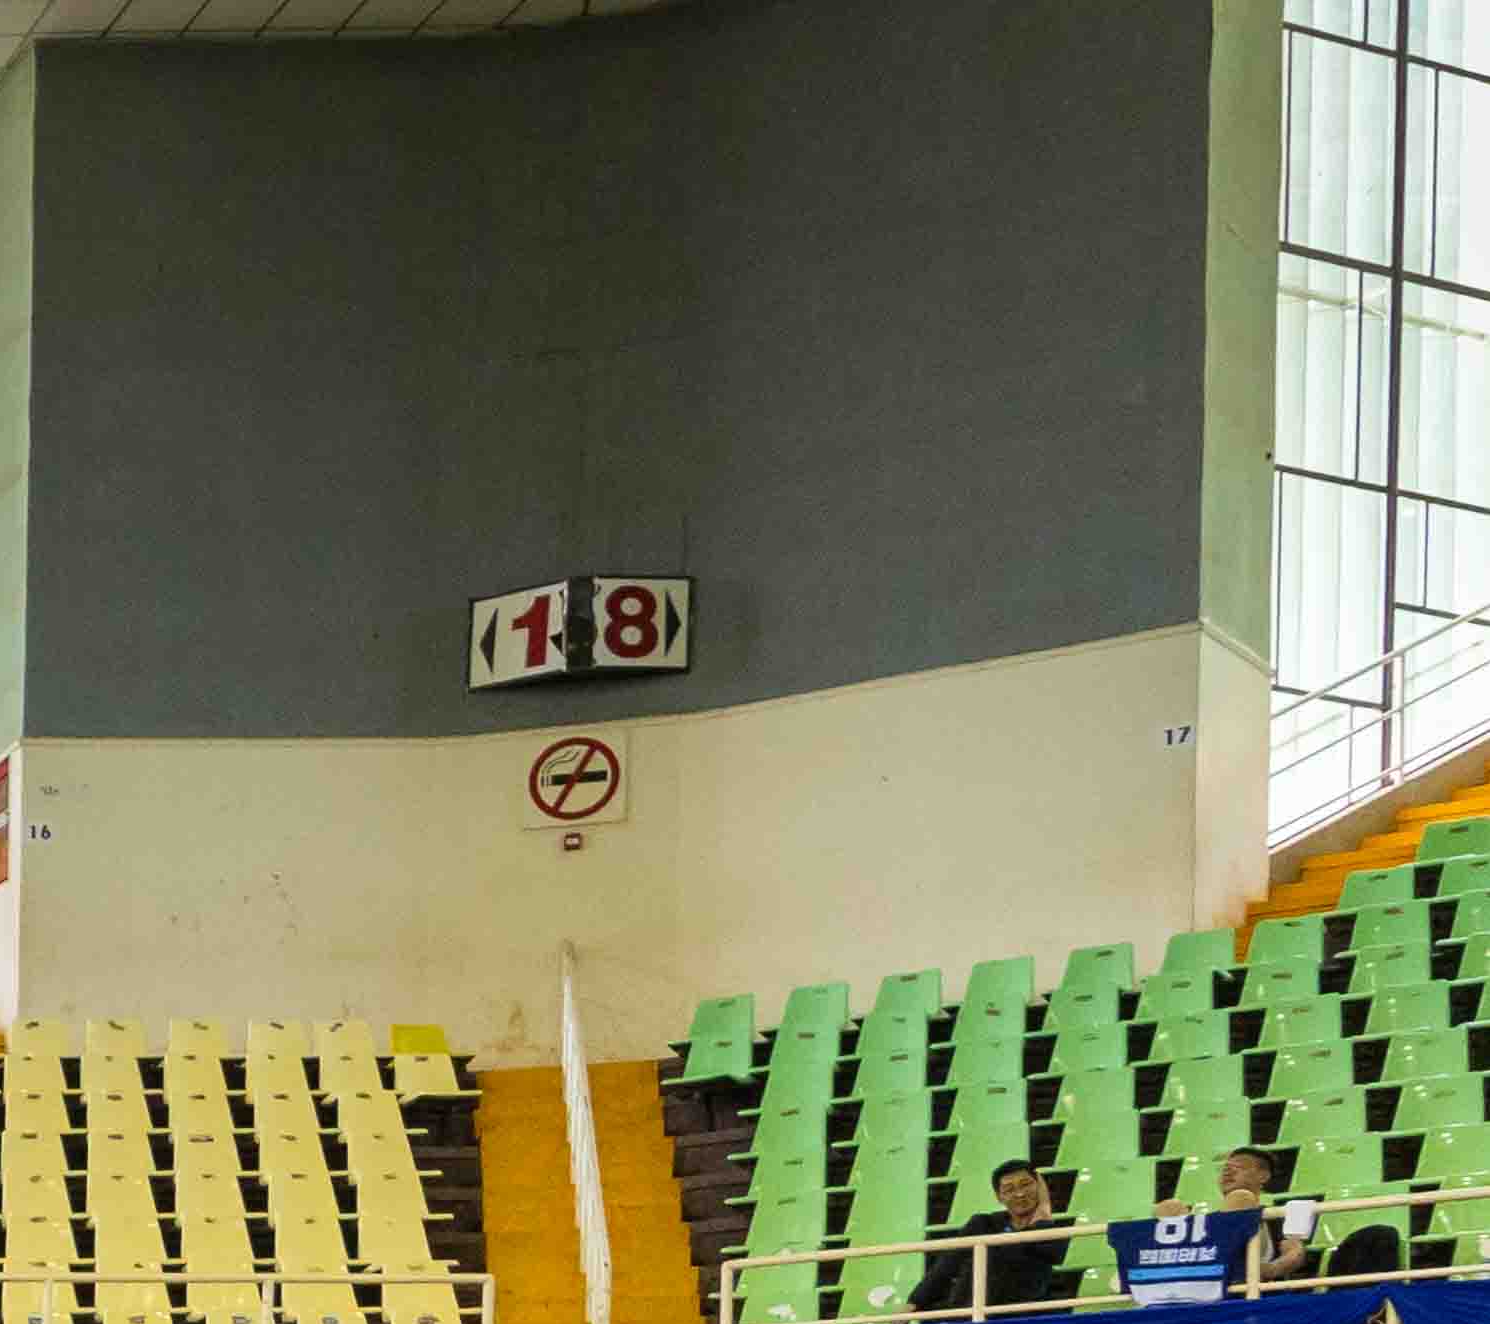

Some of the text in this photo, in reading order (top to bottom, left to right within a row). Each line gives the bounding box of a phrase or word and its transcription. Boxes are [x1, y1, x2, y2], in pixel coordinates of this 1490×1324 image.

[511, 596, 549, 667] 1
[604, 584, 659, 659] 8
[1163, 727, 1191, 747] 17
[29, 825, 52, 839] 16
